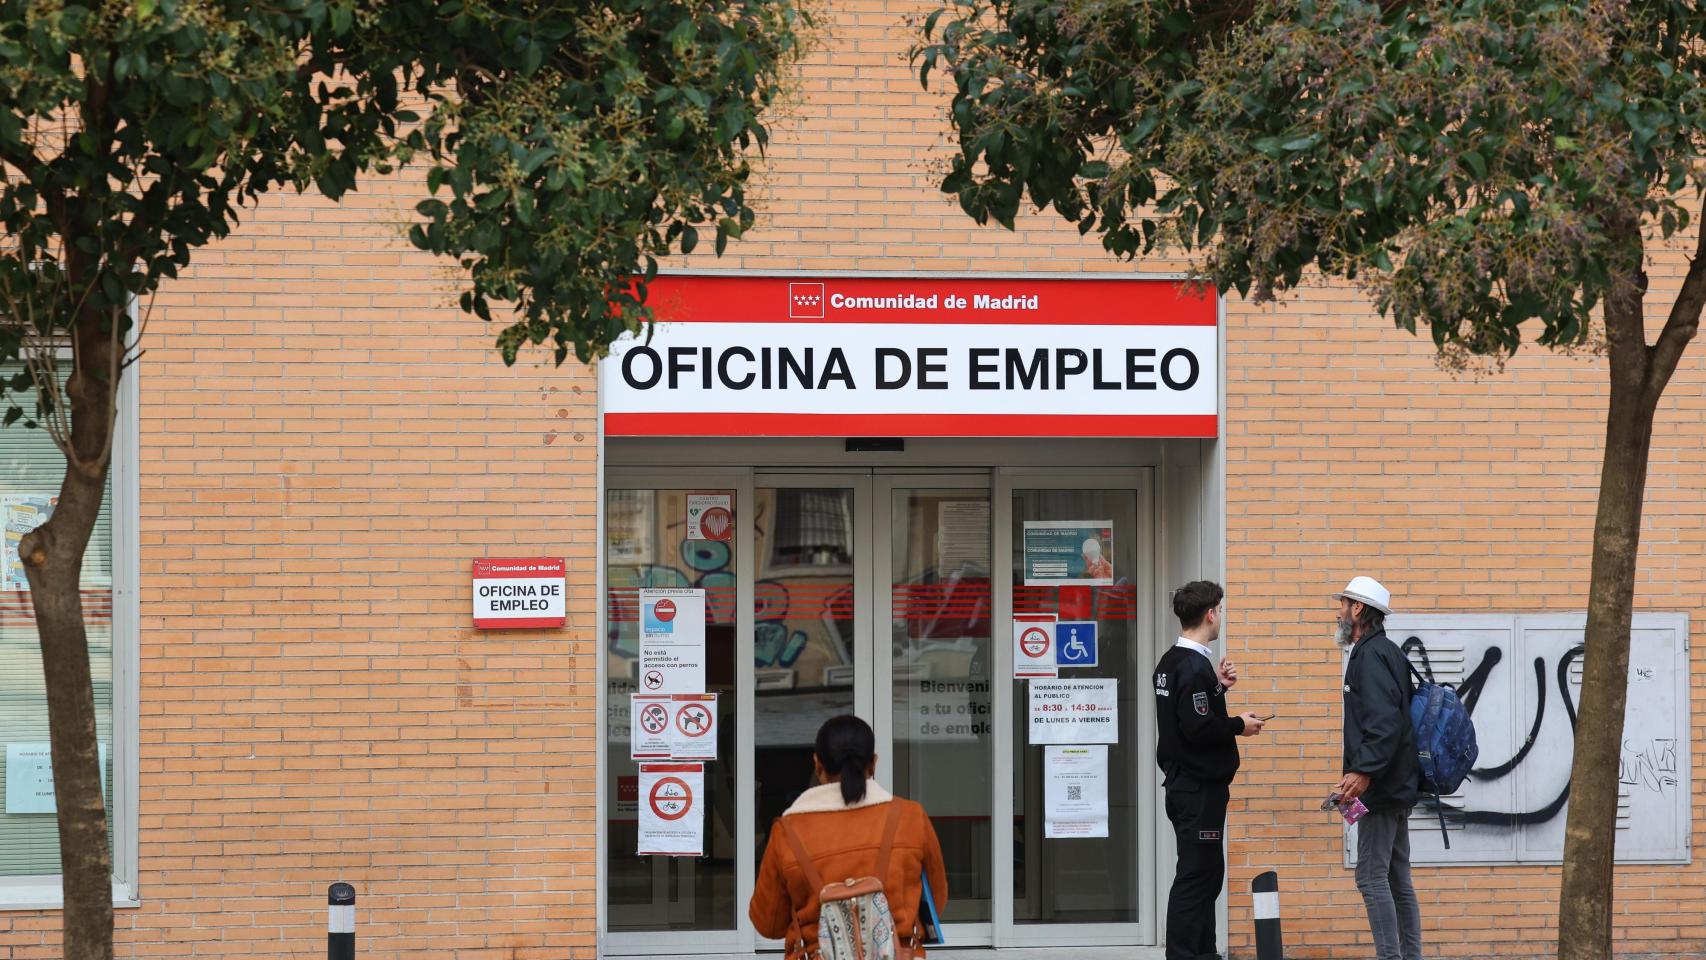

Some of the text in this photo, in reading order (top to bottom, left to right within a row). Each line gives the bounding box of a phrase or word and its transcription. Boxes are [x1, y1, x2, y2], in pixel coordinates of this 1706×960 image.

[830, 293, 1038, 310] Comunidad de Madrid
[621, 345, 1200, 391] OFICINA DE EMPLEO
[479, 585, 560, 596] OFICINA DE
[490, 600, 548, 610] EMPLEO
[920, 706, 928, 714] a
[935, 703, 951, 714] tu
[920, 722, 939, 734] de
